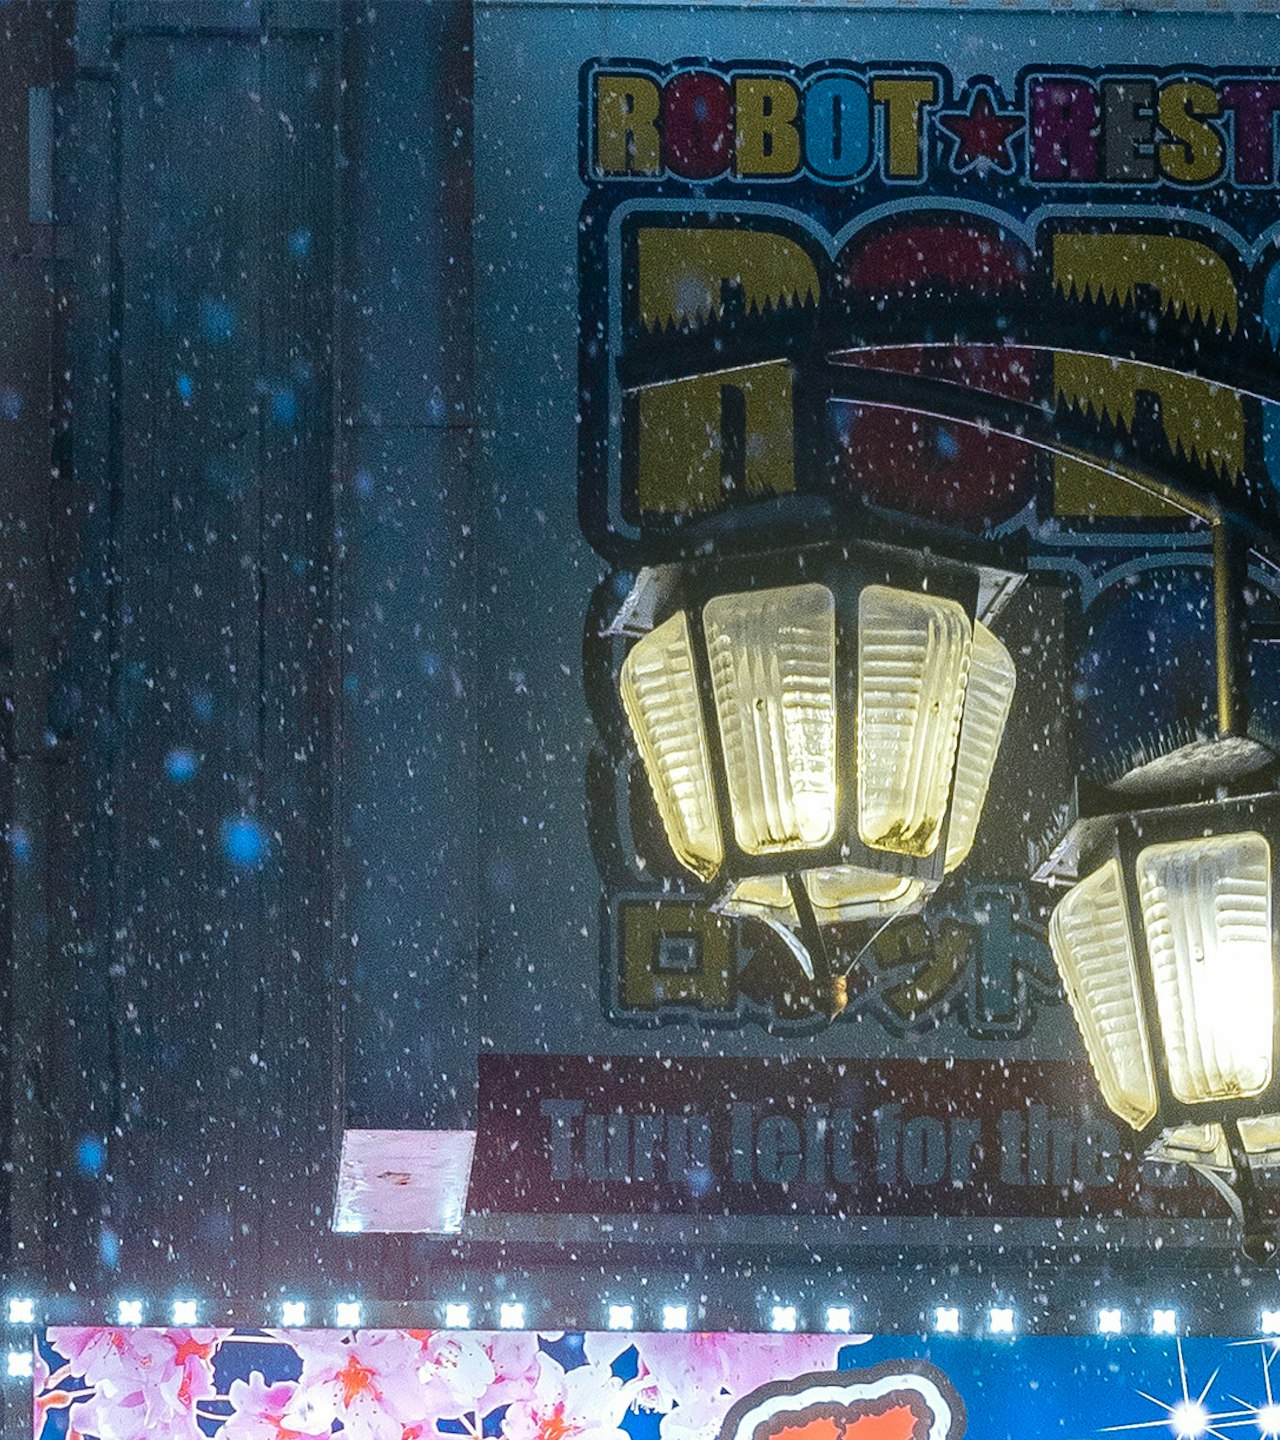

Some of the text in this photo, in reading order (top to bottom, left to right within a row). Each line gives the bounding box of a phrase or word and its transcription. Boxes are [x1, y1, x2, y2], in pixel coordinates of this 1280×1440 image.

[596, 72, 936, 178] ROBOT
[540, 1099, 711, 1183] Turn
[732, 1101, 860, 1184] left
[875, 1103, 982, 1186] for
[999, 1108, 1120, 1188] the
